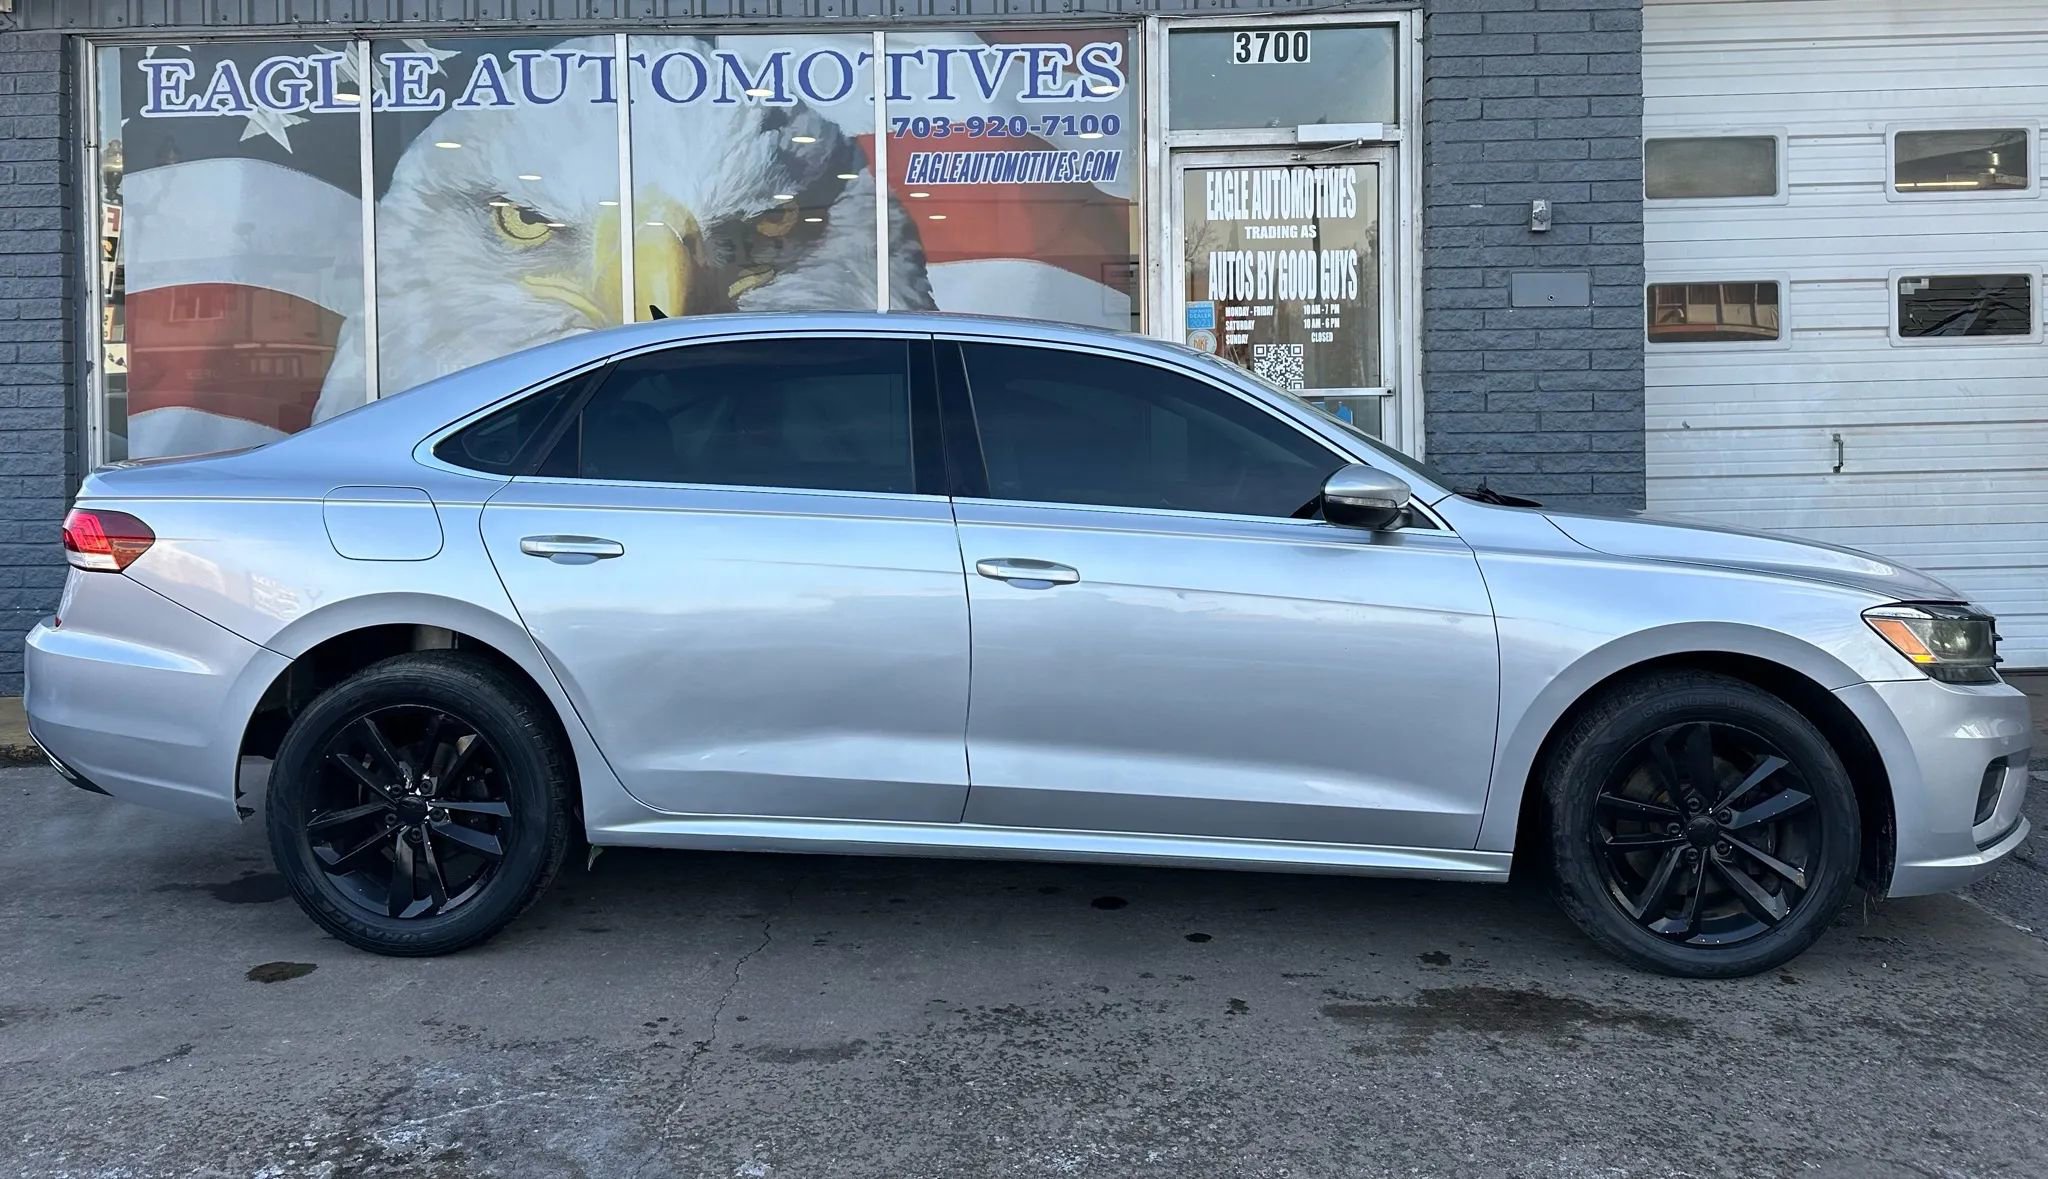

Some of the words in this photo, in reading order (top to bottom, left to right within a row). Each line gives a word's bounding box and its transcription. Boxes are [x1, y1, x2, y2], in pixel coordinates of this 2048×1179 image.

[1236, 31, 1308, 63] 3700
[141, 52, 444, 115] EAGLE
[455, 46, 1123, 107] AUTOMOTIVES
[892, 114, 1121, 139] 703-920-7100
[905, 150, 1121, 185] EAGLEAUTOMOTIVES.COM
[1206, 170, 1249, 221] EAGLE
[1252, 167, 1356, 220] AUTOMOTIVES
[1245, 226, 1298, 239] TRADING
[1301, 225, 1317, 238] AS
[1208, 250, 1254, 301] AUTOS
[1257, 250, 1276, 300] BY
[1278, 249, 1317, 301] GOOD
[1320, 249, 1357, 301] GUYS
[1225, 306, 1250, 317] MONDAY
[1253, 305, 1274, 316] FRIDAY
[1303, 304, 1310, 315] 10
[1311, 304, 1320, 315] AM
[1325, 303, 1329, 315] 7
[1330, 303, 1340, 315] PM
[1225, 320, 1255, 331] SATURDAY
[1303, 318, 1310, 329] 10
[1311, 318, 1321, 329] AM
[1325, 317, 1330, 329] 6
[1330, 317, 1340, 329] PM
[1225, 333, 1249, 345] SUNDAY
[1311, 331, 1334, 343] CLOSED
